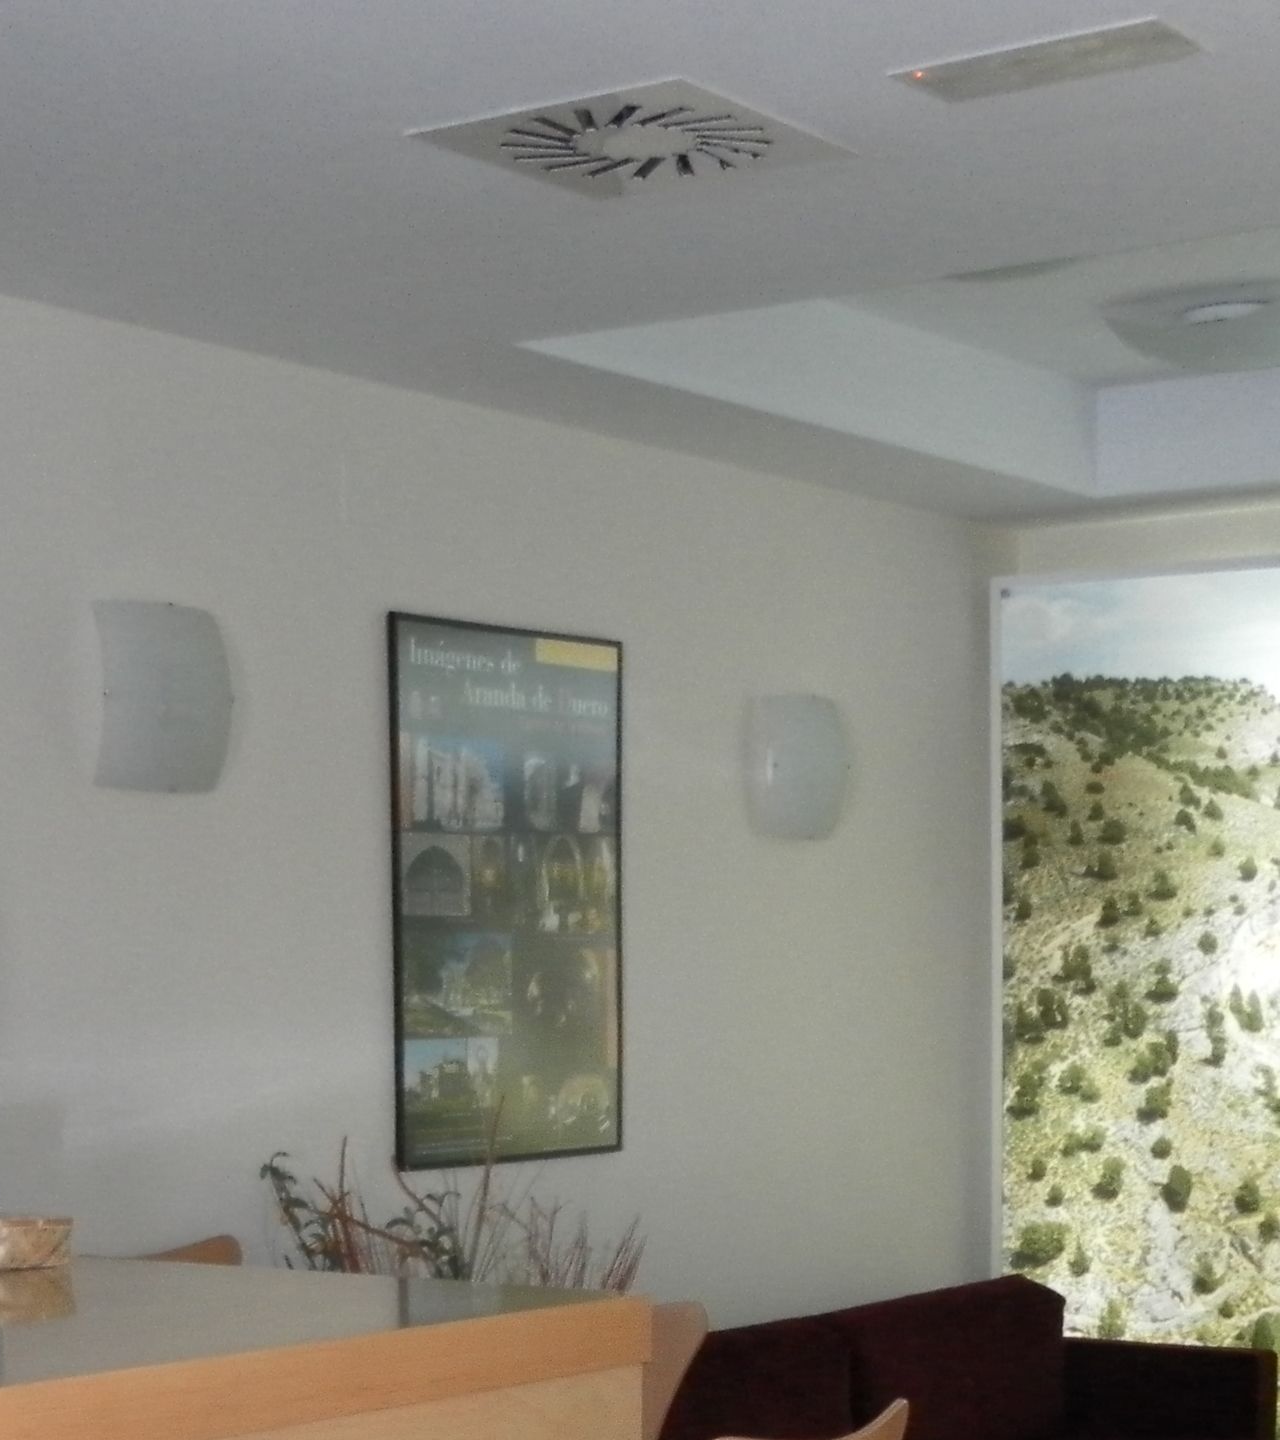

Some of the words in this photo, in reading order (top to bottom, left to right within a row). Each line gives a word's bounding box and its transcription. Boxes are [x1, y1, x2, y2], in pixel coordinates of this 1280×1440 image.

[409, 636, 496, 676] Imágenes
[501, 649, 520, 674] de
[464, 680, 526, 711] Aranda
[532, 685, 551, 712] de
